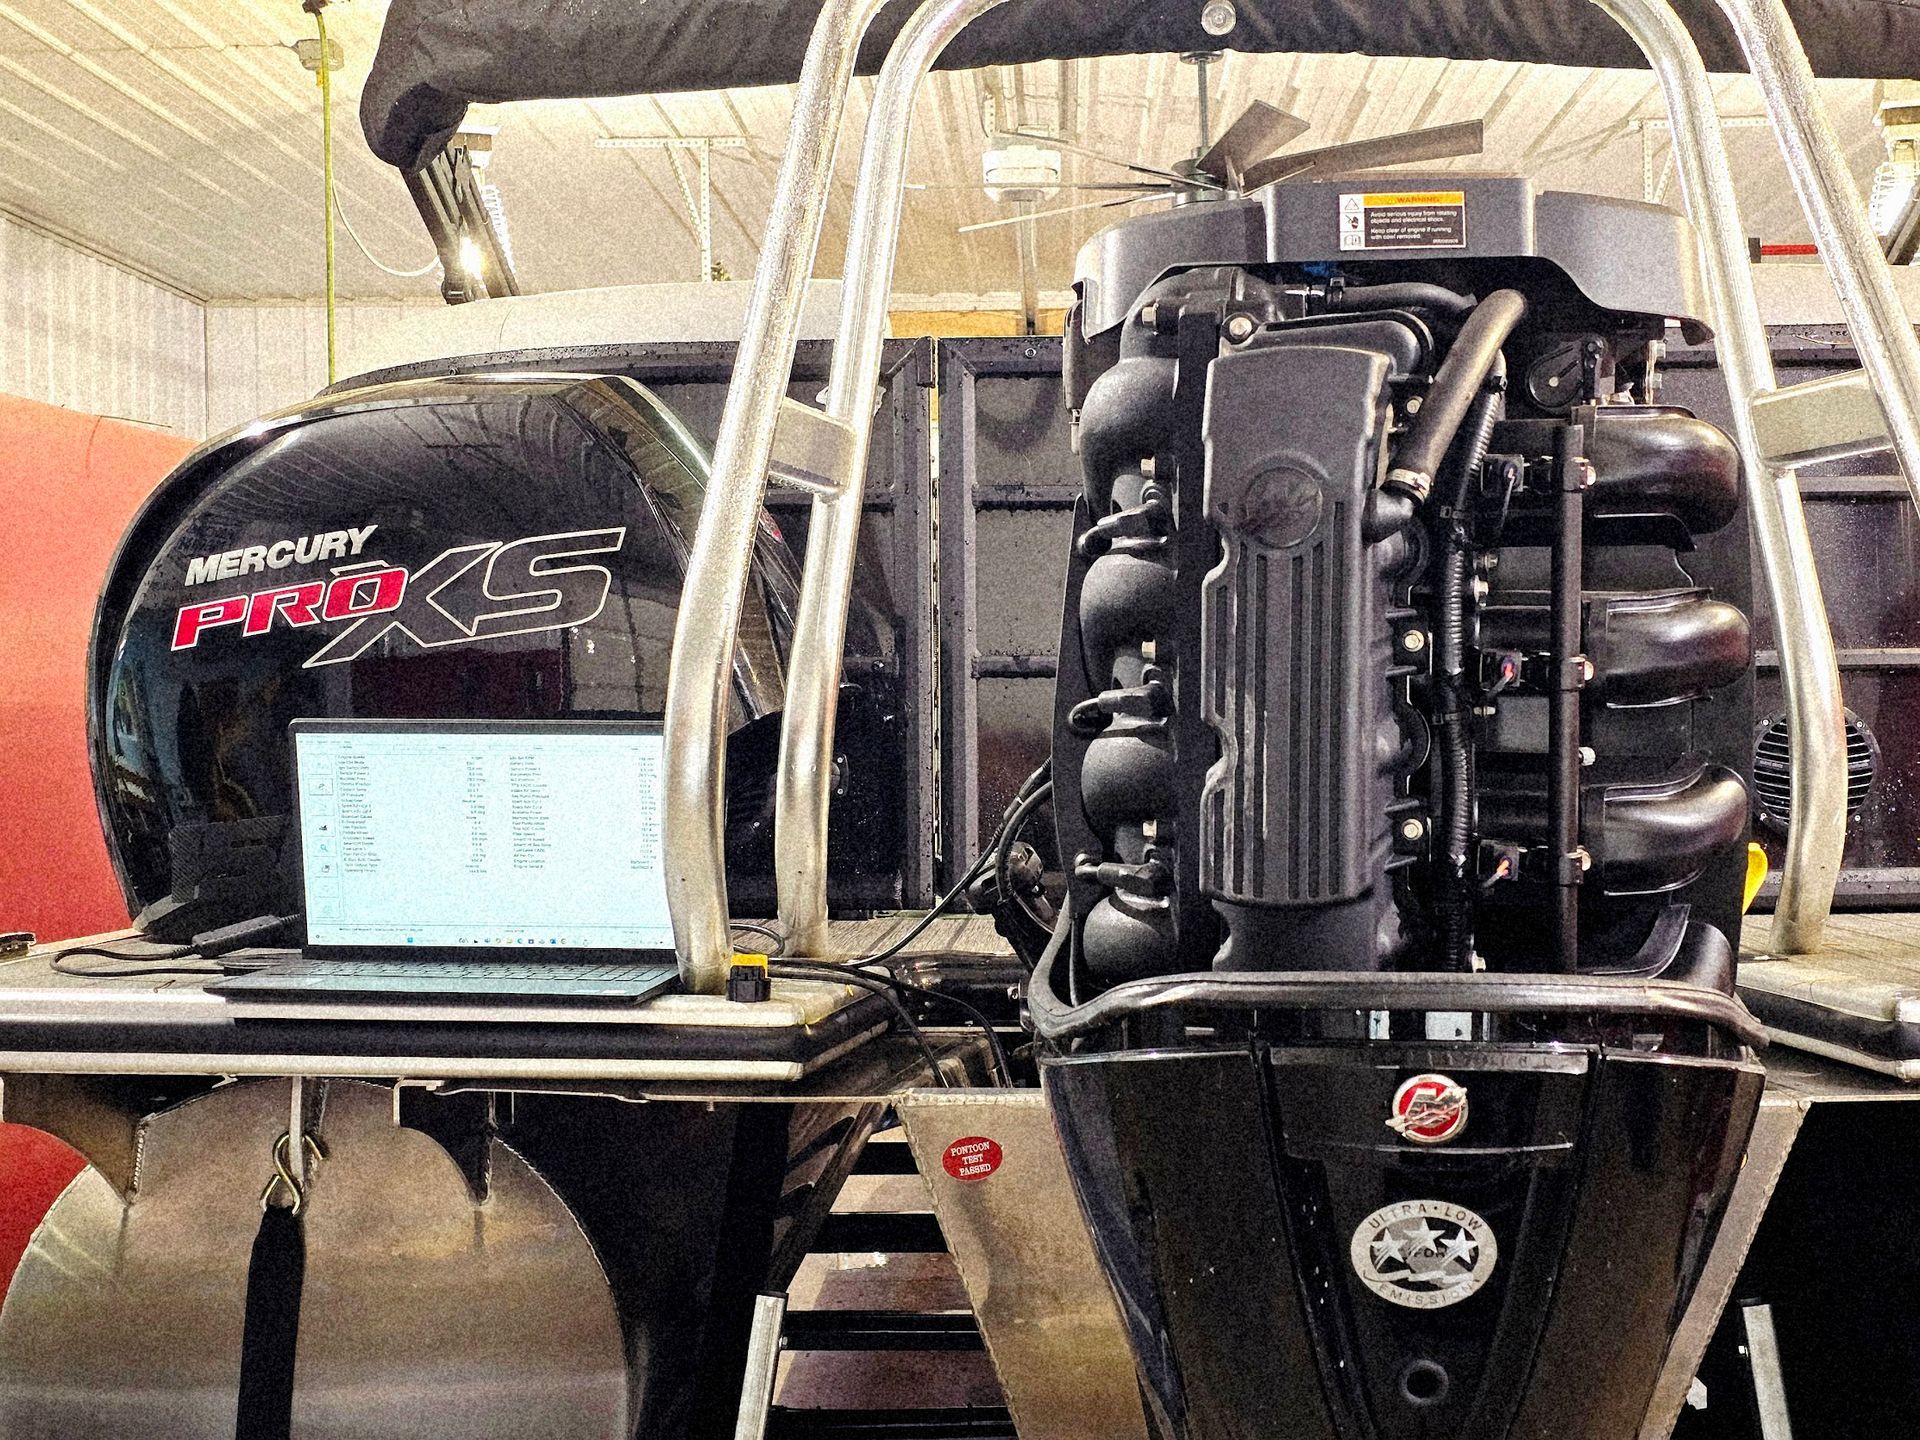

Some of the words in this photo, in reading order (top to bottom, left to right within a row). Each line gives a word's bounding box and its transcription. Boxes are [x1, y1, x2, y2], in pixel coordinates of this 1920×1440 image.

[184, 524, 379, 587] MERCURY
[171, 566, 409, 651] PRO
[302, 526, 627, 668] XS
[951, 1141, 990, 1156] PONTOON
[959, 1163, 991, 1176] PASSED
[962, 1154, 984, 1165] TEST
[1368, 1203, 1427, 1229] ULTRA
[1445, 1206, 1483, 1230] LOW
